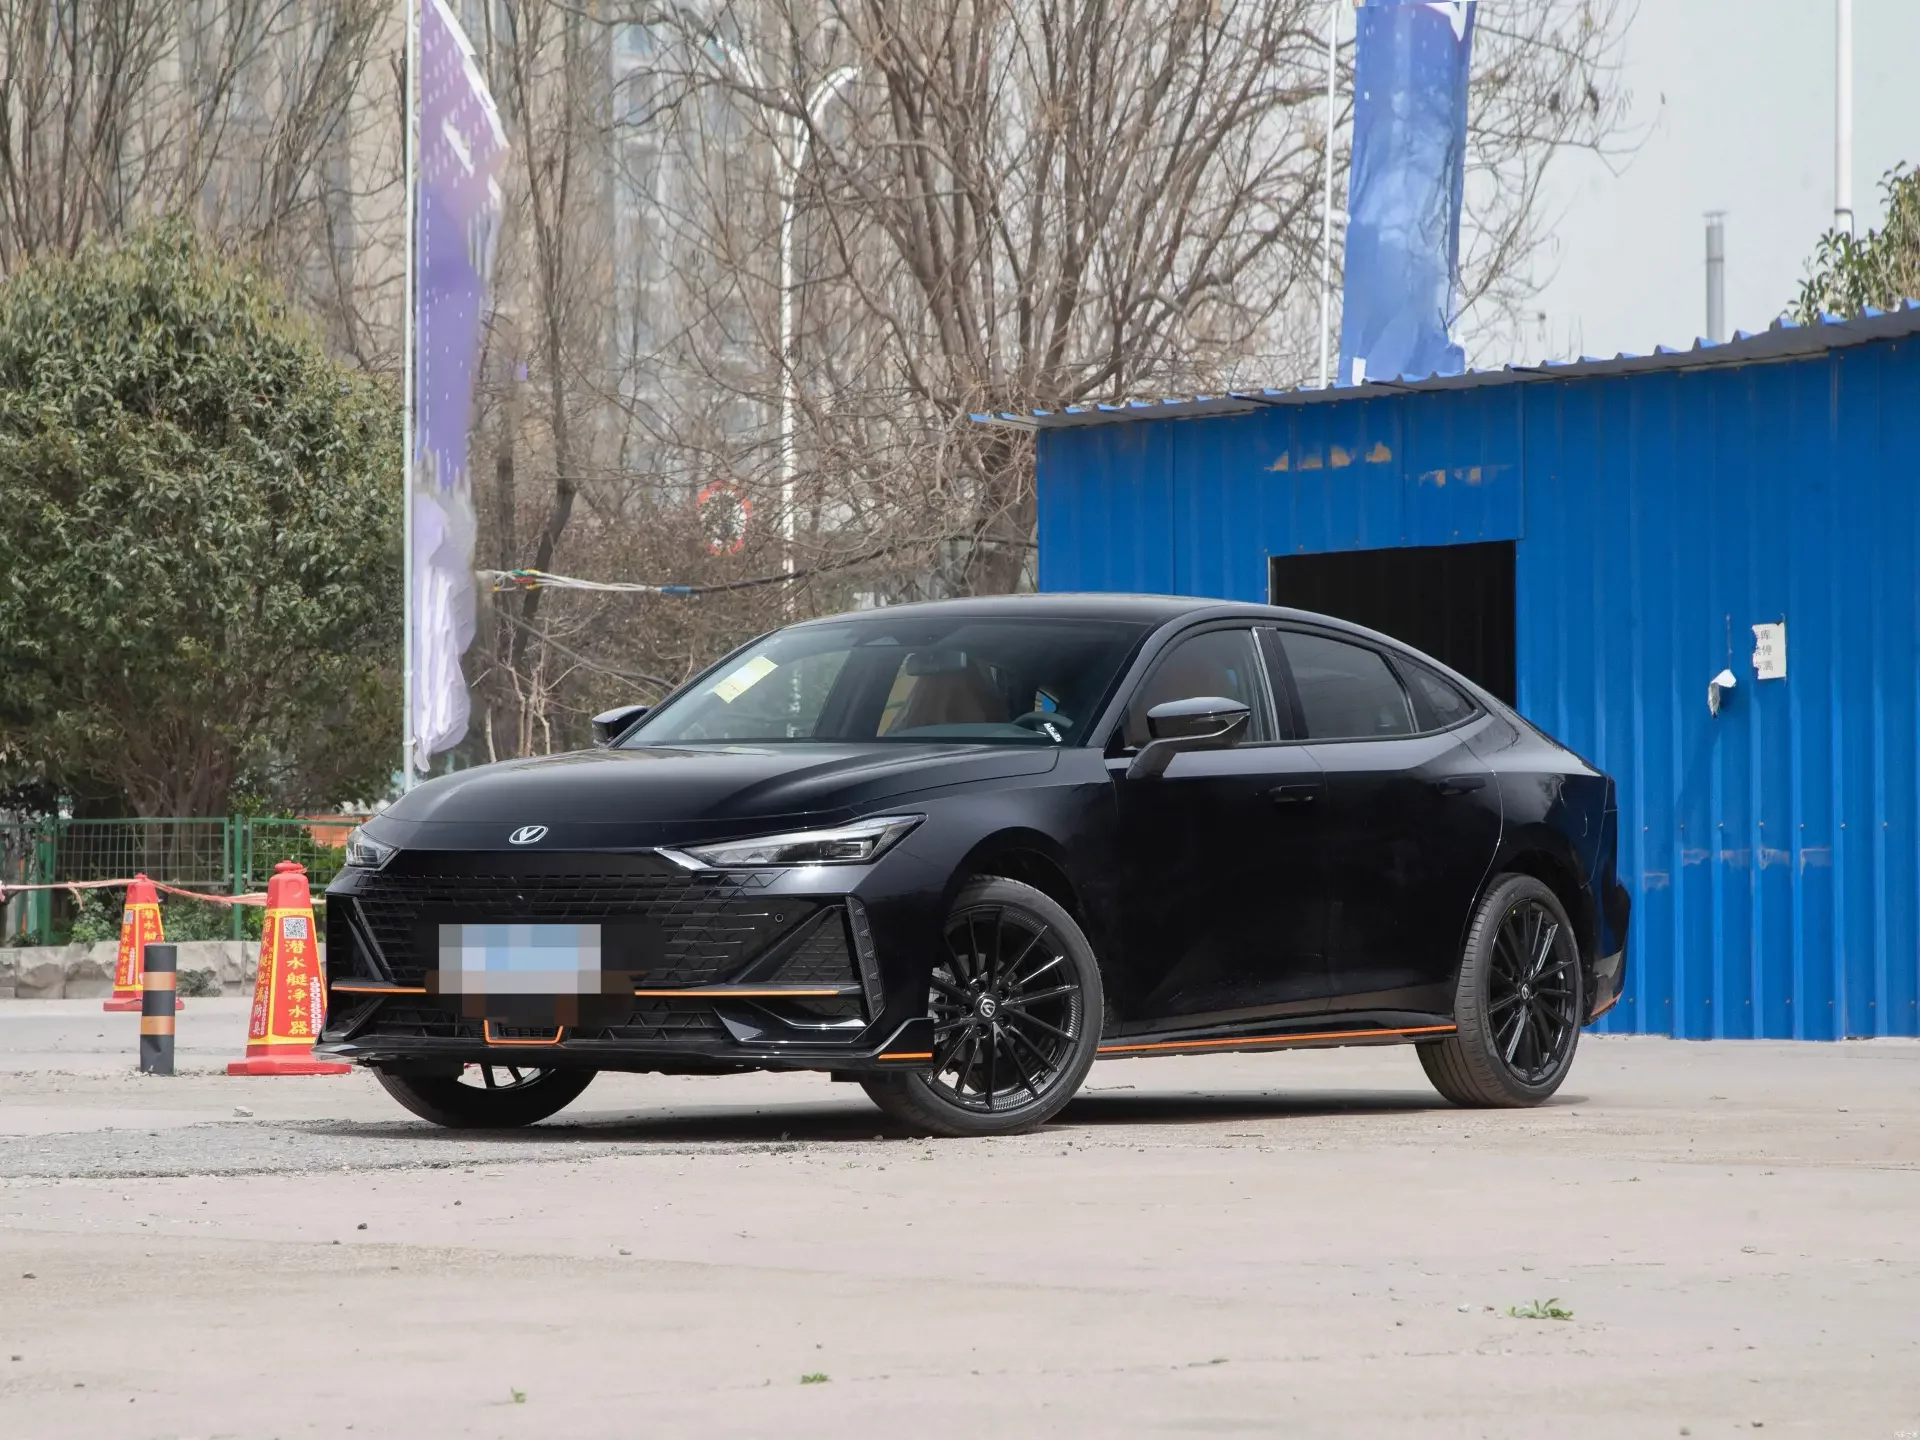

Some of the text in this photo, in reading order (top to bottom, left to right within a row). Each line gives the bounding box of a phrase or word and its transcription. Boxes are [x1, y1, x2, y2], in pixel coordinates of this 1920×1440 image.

[284, 939, 310, 1035] 潜水艇净水器
